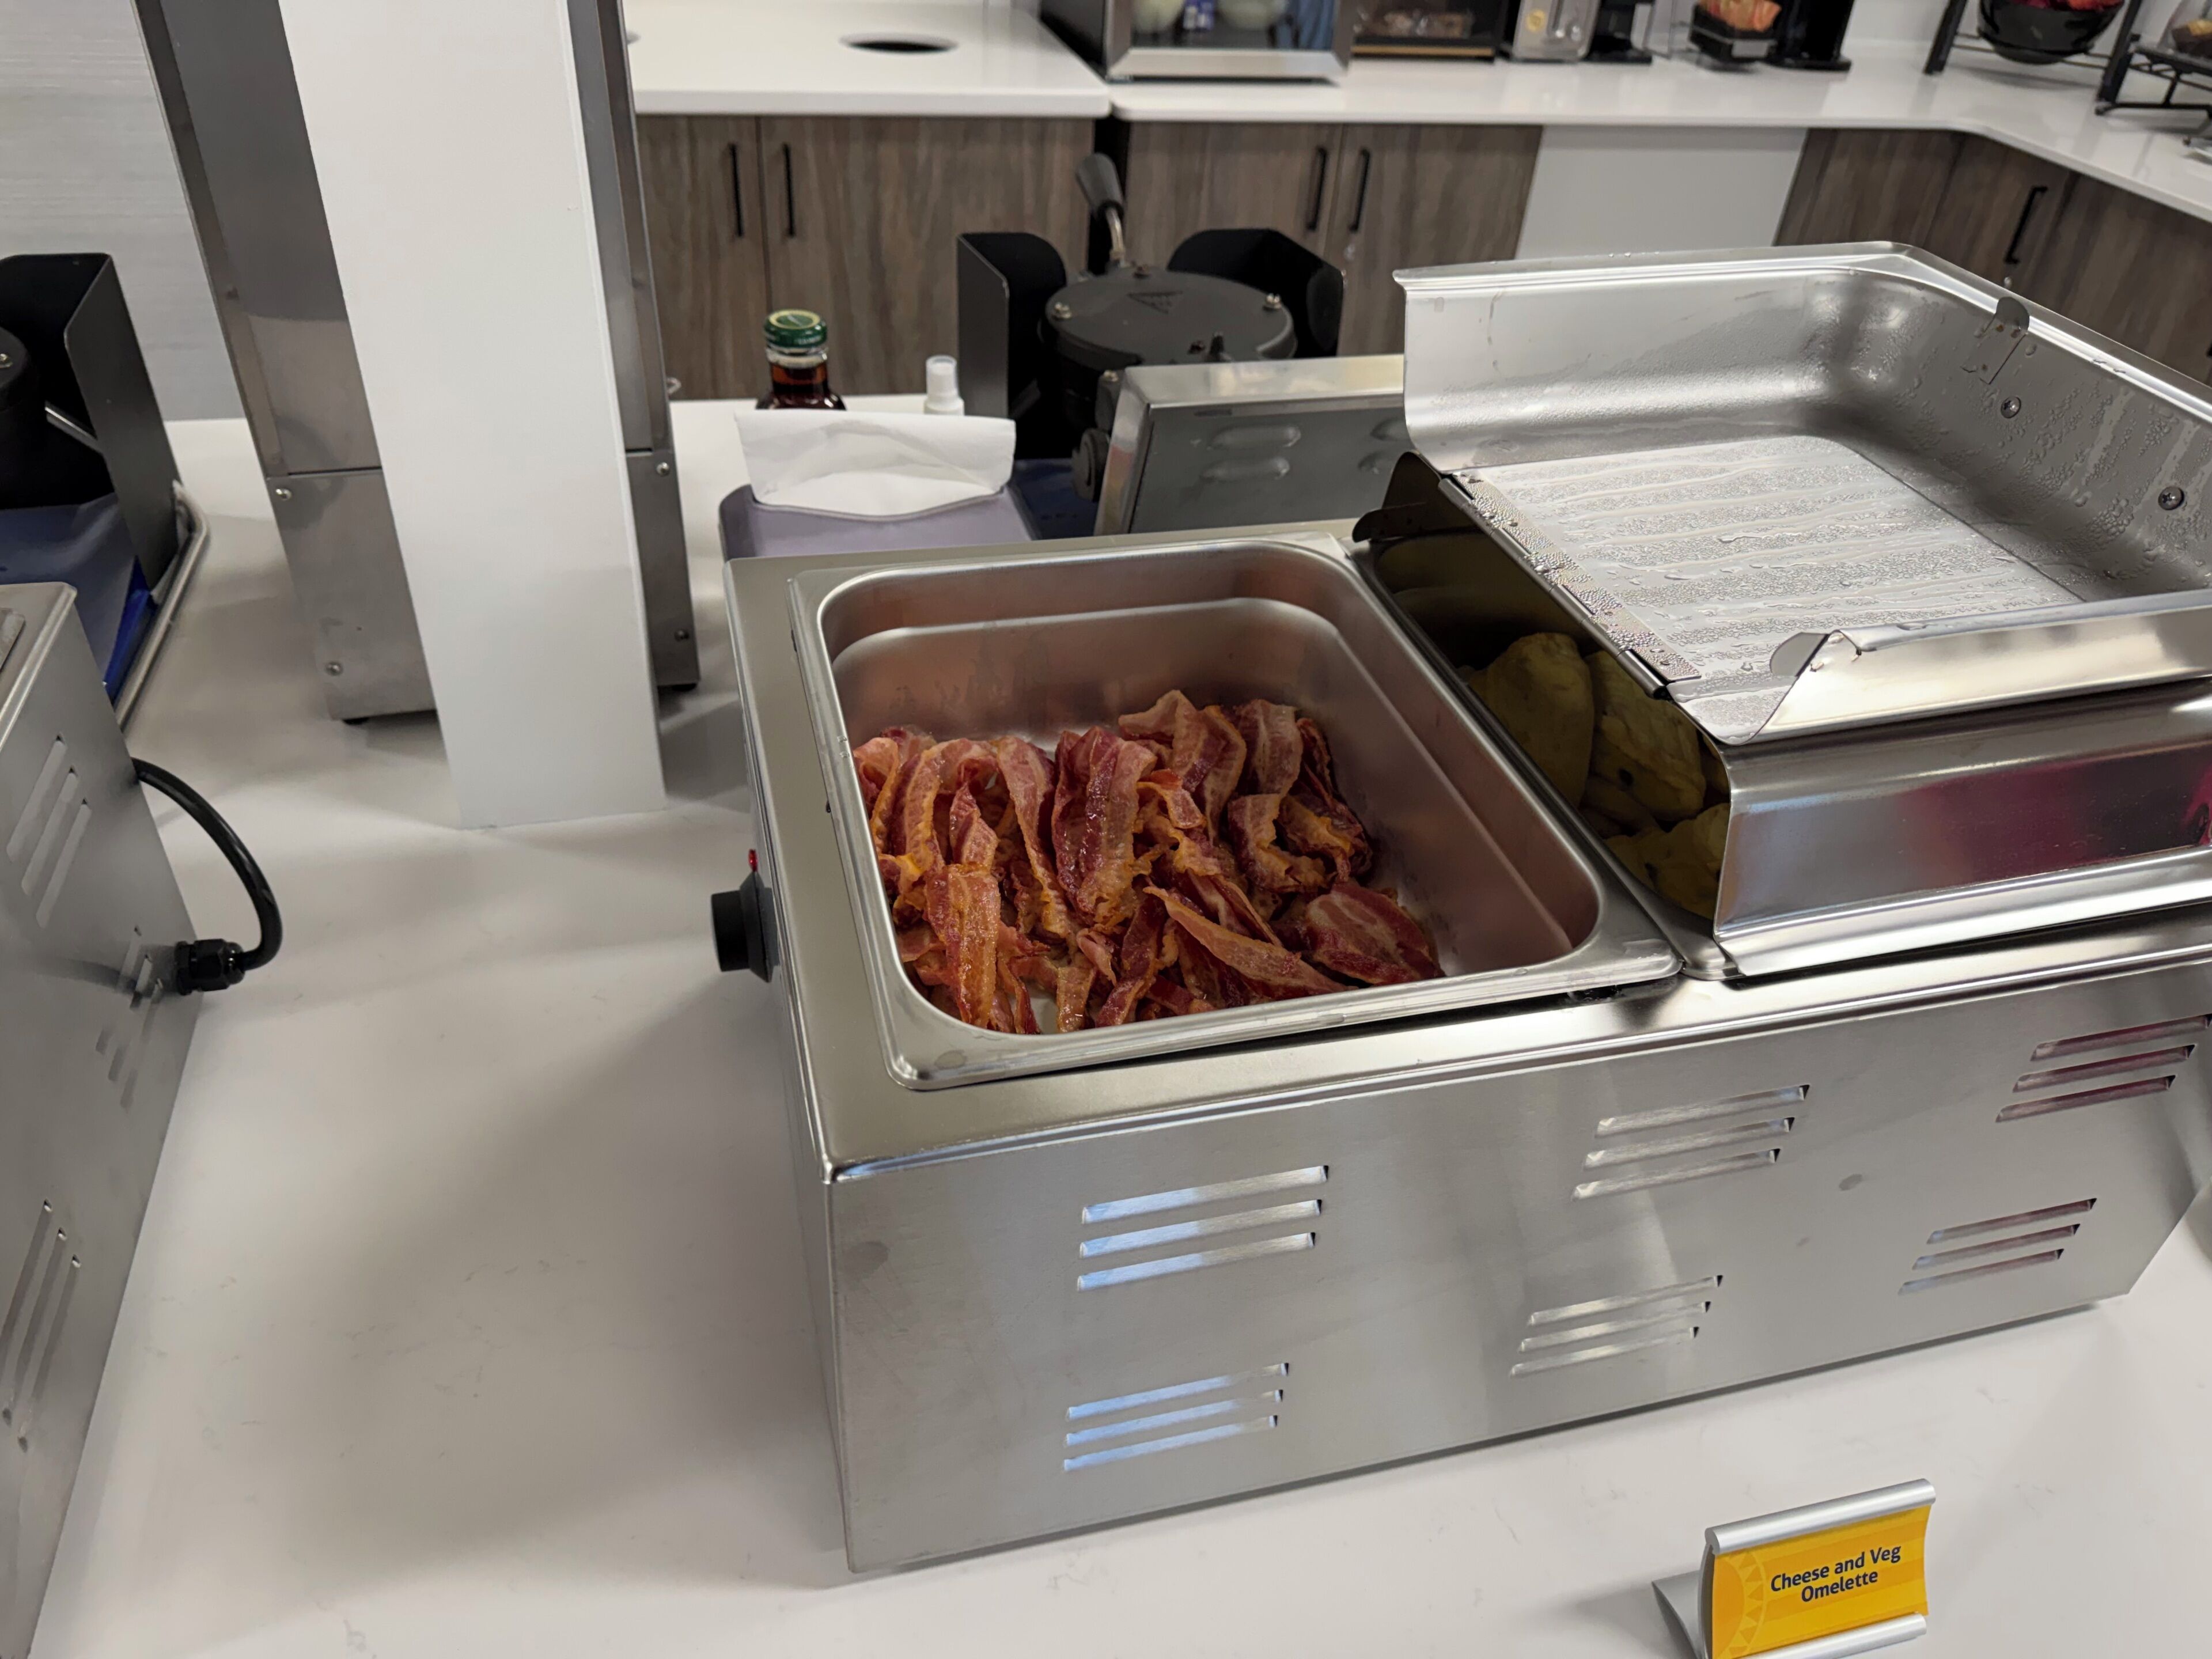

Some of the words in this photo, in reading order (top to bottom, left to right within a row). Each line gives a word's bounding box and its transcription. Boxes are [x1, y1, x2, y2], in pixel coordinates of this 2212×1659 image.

[1771, 1566, 1830, 1592] Cheese
[1835, 1551, 1865, 1574] and
[1870, 1546, 1902, 1563] Veg
[1801, 1571, 1878, 1603] Omelette
